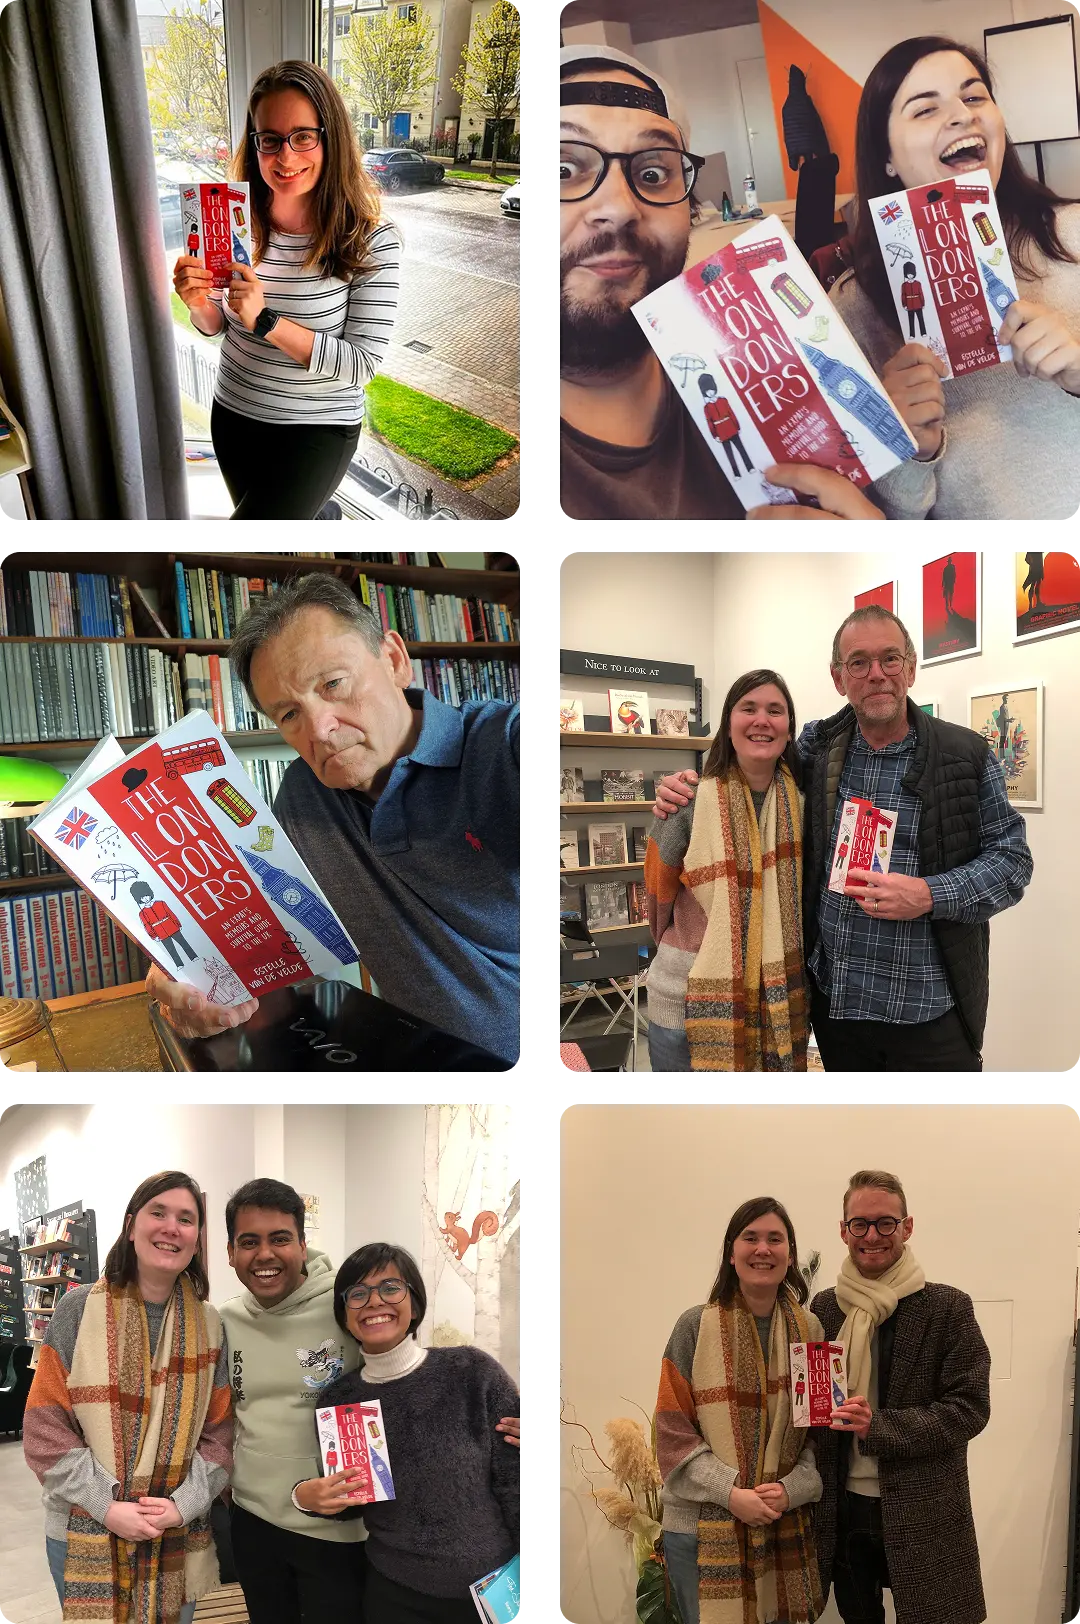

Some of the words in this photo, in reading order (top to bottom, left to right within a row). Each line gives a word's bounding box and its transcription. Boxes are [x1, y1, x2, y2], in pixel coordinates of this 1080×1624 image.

[206, 195, 223, 206] THE
[921, 200, 954, 224] THE
[202, 206, 229, 222] LON
[204, 222, 230, 238] DON
[918, 218, 970, 254] LON
[206, 237, 230, 252] ERS
[926, 244, 974, 280] DON
[699, 272, 744, 312] THE
[933, 272, 980, 306] ERS
[970, 308, 980, 318] AND
[722, 324, 796, 390] DON
[954, 362, 966, 371] VAN
[967, 358, 976, 368] DE
[977, 352, 996, 364] VELDE
[961, 347, 986, 360] ESTELLE
[744, 364, 810, 424] ERS
[799, 450, 809, 460] TO
[1030, 611, 1056, 622] GRAPHIC
[1057, 604, 1079, 615] NOVEL
[120, 776, 176, 821] THE
[130, 796, 214, 862] LON
[855, 824, 876, 840] LON
[861, 815, 875, 826] THE
[853, 837, 873, 853] DON
[158, 832, 235, 893] DON
[851, 850, 870, 865] ERS
[32, 900, 41, 911] all
[48, 899, 58, 909] all
[64, 896, 73, 907] all
[80, 894, 88, 905] all
[184, 869, 251, 921] ERS
[16, 915, 26, 940] about
[34, 911, 43, 937] about
[49, 910, 60, 936] about
[65, 907, 76, 932] about
[81, 905, 92, 930] about
[221, 920, 232, 931] AN
[231, 907, 252, 925] EXPAT'S
[225, 921, 249, 940] MEMOIRS
[250, 913, 262, 925] AND
[0, 916, 9, 944] about
[230, 930, 255, 948] SURVIVAL
[254, 919, 272, 932] GUIDE
[36, 937, 46, 968] science
[51, 935, 62, 965] science
[68, 932, 79, 962] science
[84, 929, 94, 960] science
[100, 929, 110, 957] science
[242, 941, 252, 951] TO
[251, 934, 262, 946] THE
[2, 944, 12, 976] science
[18, 940, 30, 971] science
[253, 958, 286, 976] ESTELLE
[249, 977, 265, 989] VAN
[265, 973, 277, 983] DE
[277, 963, 303, 977] VELDE
[289, 1017, 358, 1062] VAIO
[808, 1359, 830, 1371] LON
[812, 1350, 825, 1359] THE
[809, 1371, 830, 1383] DON
[810, 1383, 830, 1395] ERS
[339, 1423, 365, 1438] LON
[341, 1413, 358, 1424] THE
[340, 1437, 367, 1452] DON
[343, 1450, 368, 1466] ERS
